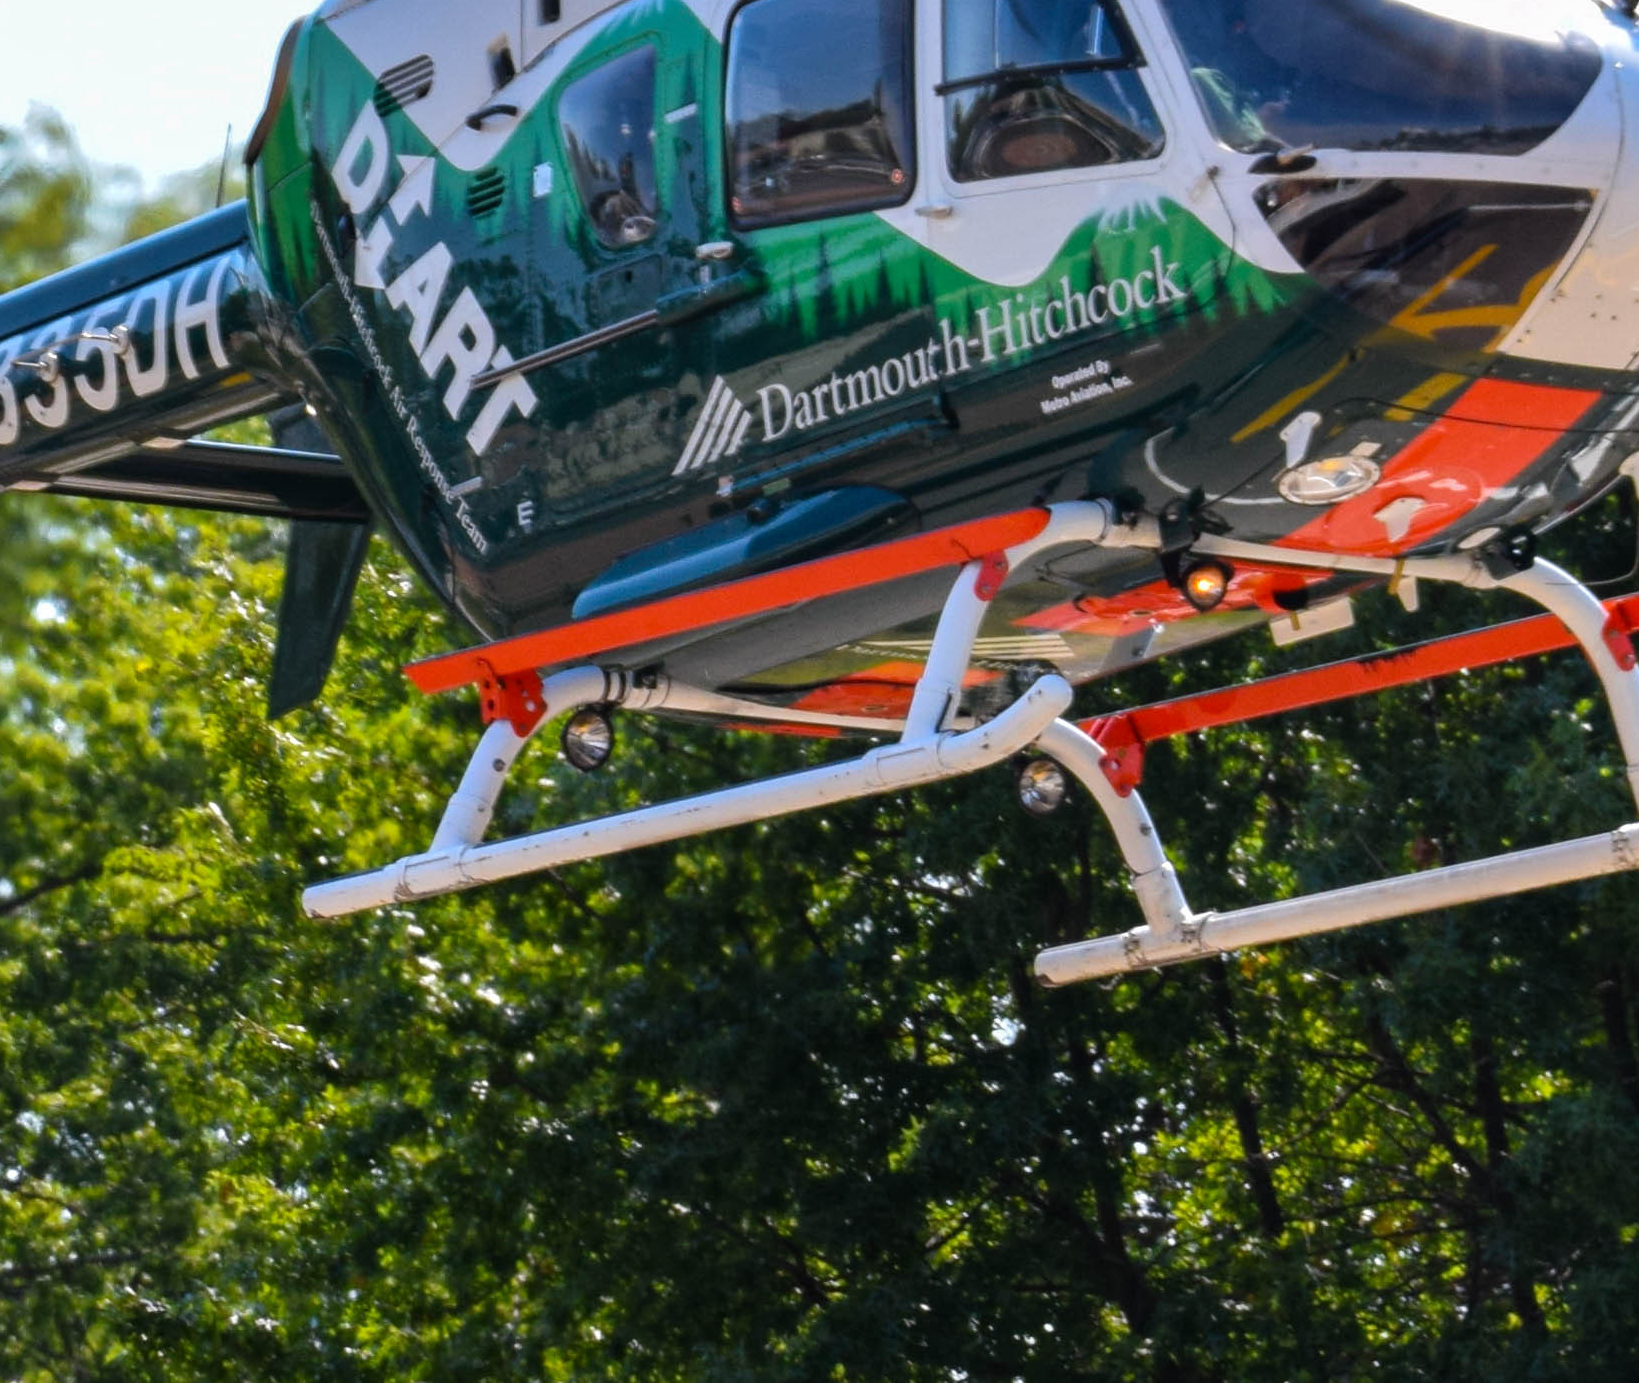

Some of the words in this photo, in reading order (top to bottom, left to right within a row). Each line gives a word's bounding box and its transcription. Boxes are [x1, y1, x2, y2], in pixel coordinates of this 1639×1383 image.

[756, 246, 1190, 444] Dartmouth-Hitchcock
[1051, 363, 1096, 390] Operated
[1095, 359, 1110, 375] By
[1040, 396, 1070, 415] Metro
[389, 386, 409, 419] Air
[407, 415, 455, 505] Response
[456, 496, 488, 556] Team
